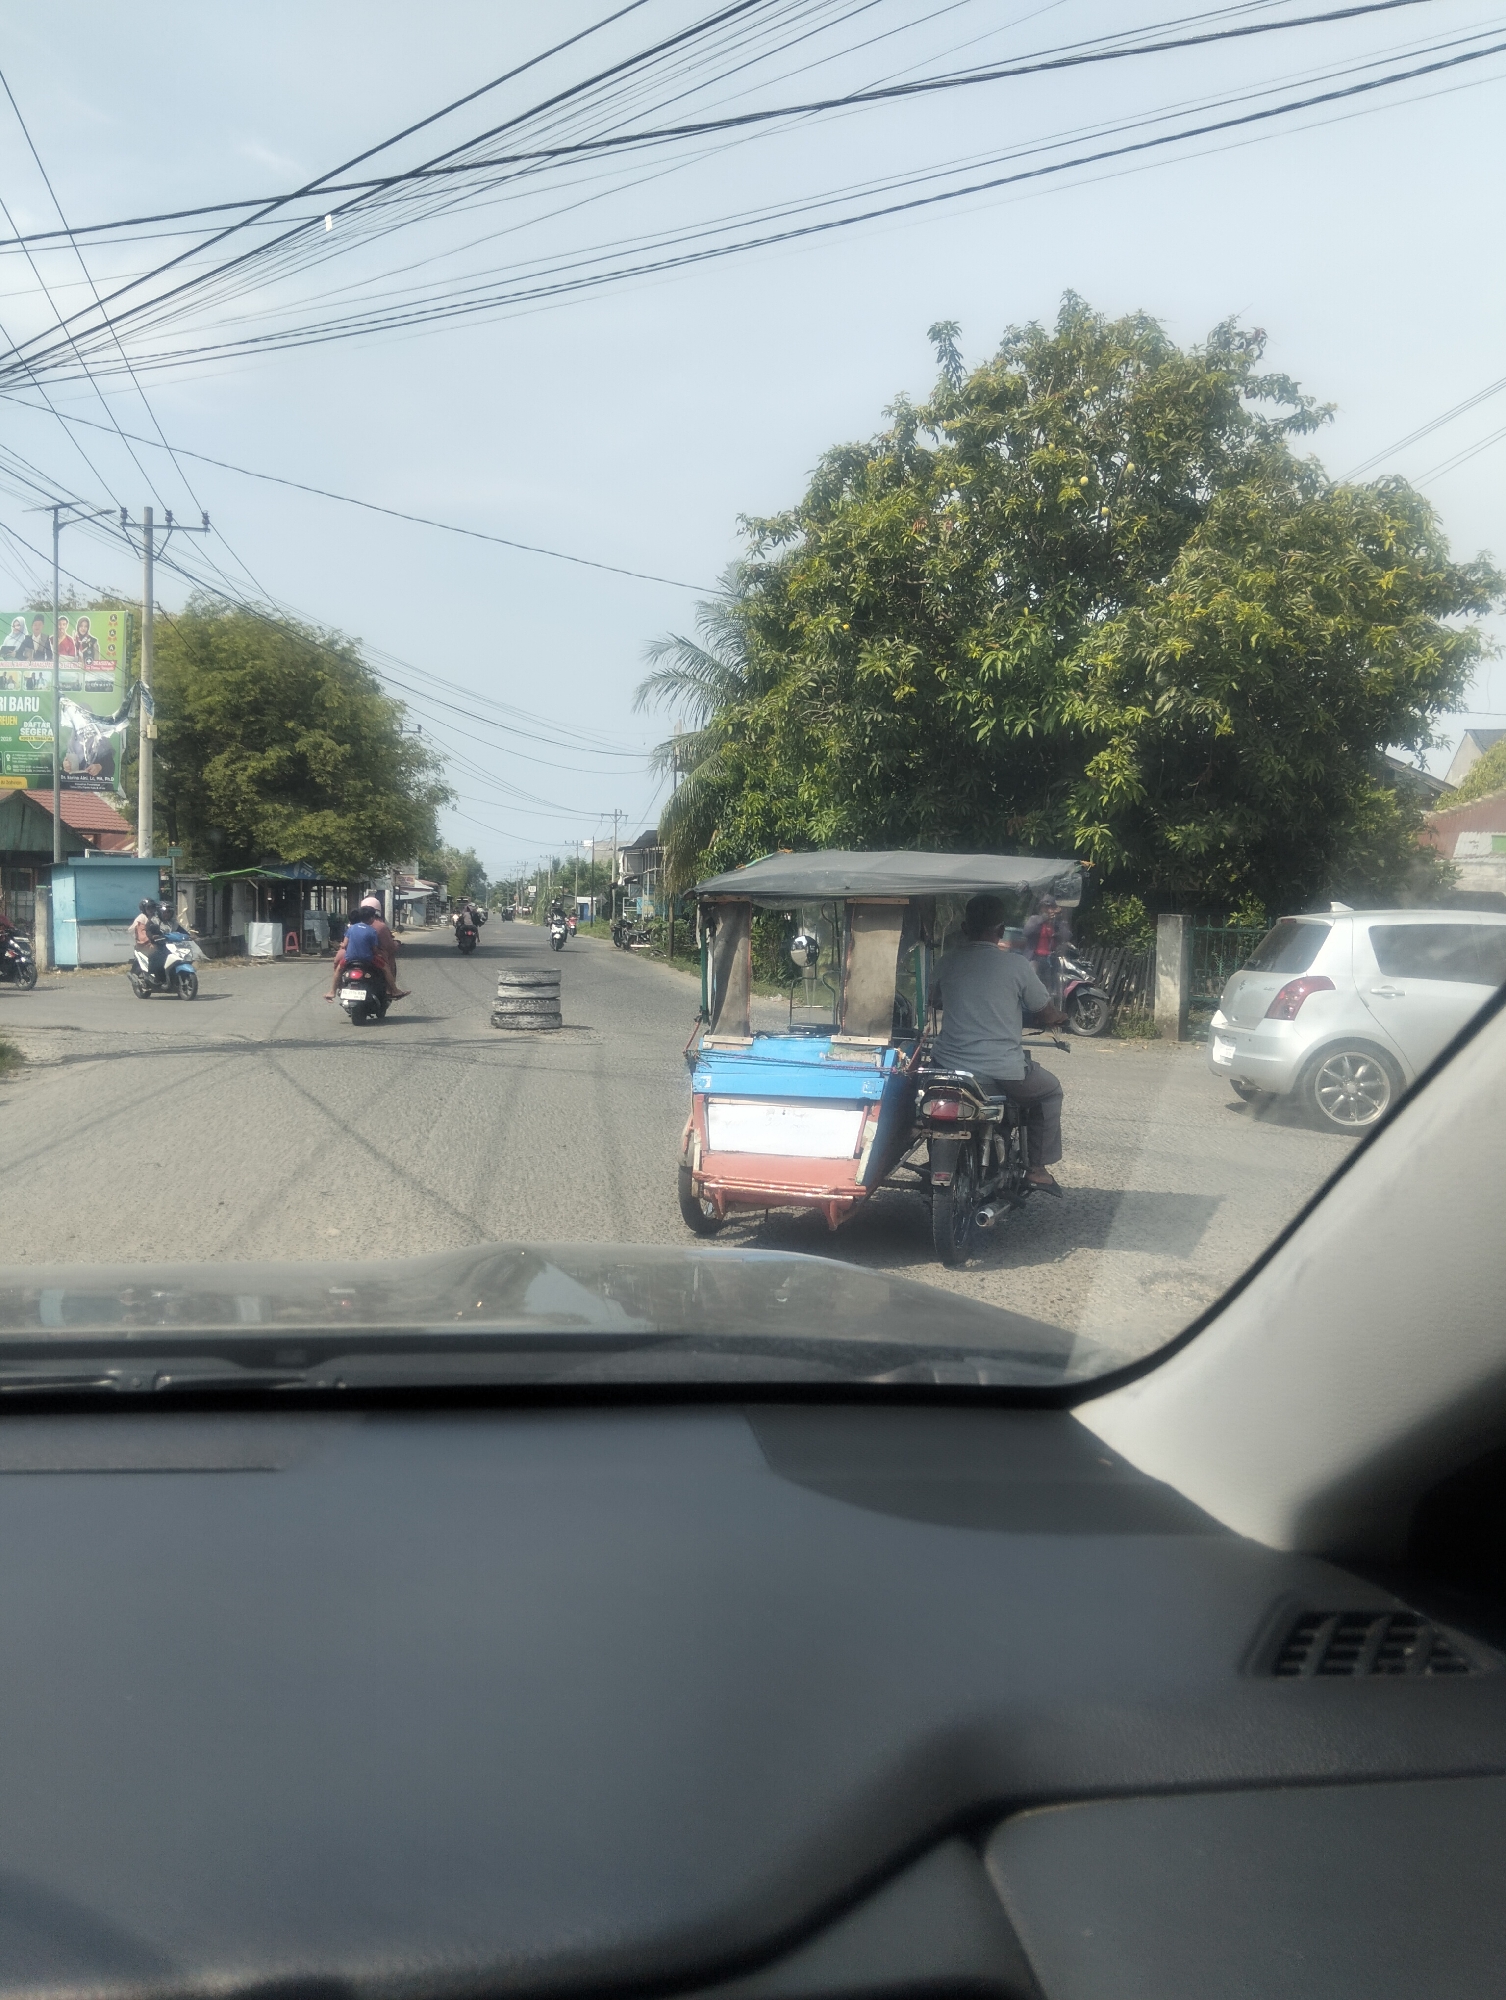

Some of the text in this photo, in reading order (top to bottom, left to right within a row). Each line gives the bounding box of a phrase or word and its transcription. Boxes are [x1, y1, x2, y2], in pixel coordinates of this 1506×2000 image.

[9, 696, 40, 713] BARU
[23, 721, 51, 729] DAFTAR
[20, 727, 54, 737] SEGERA
